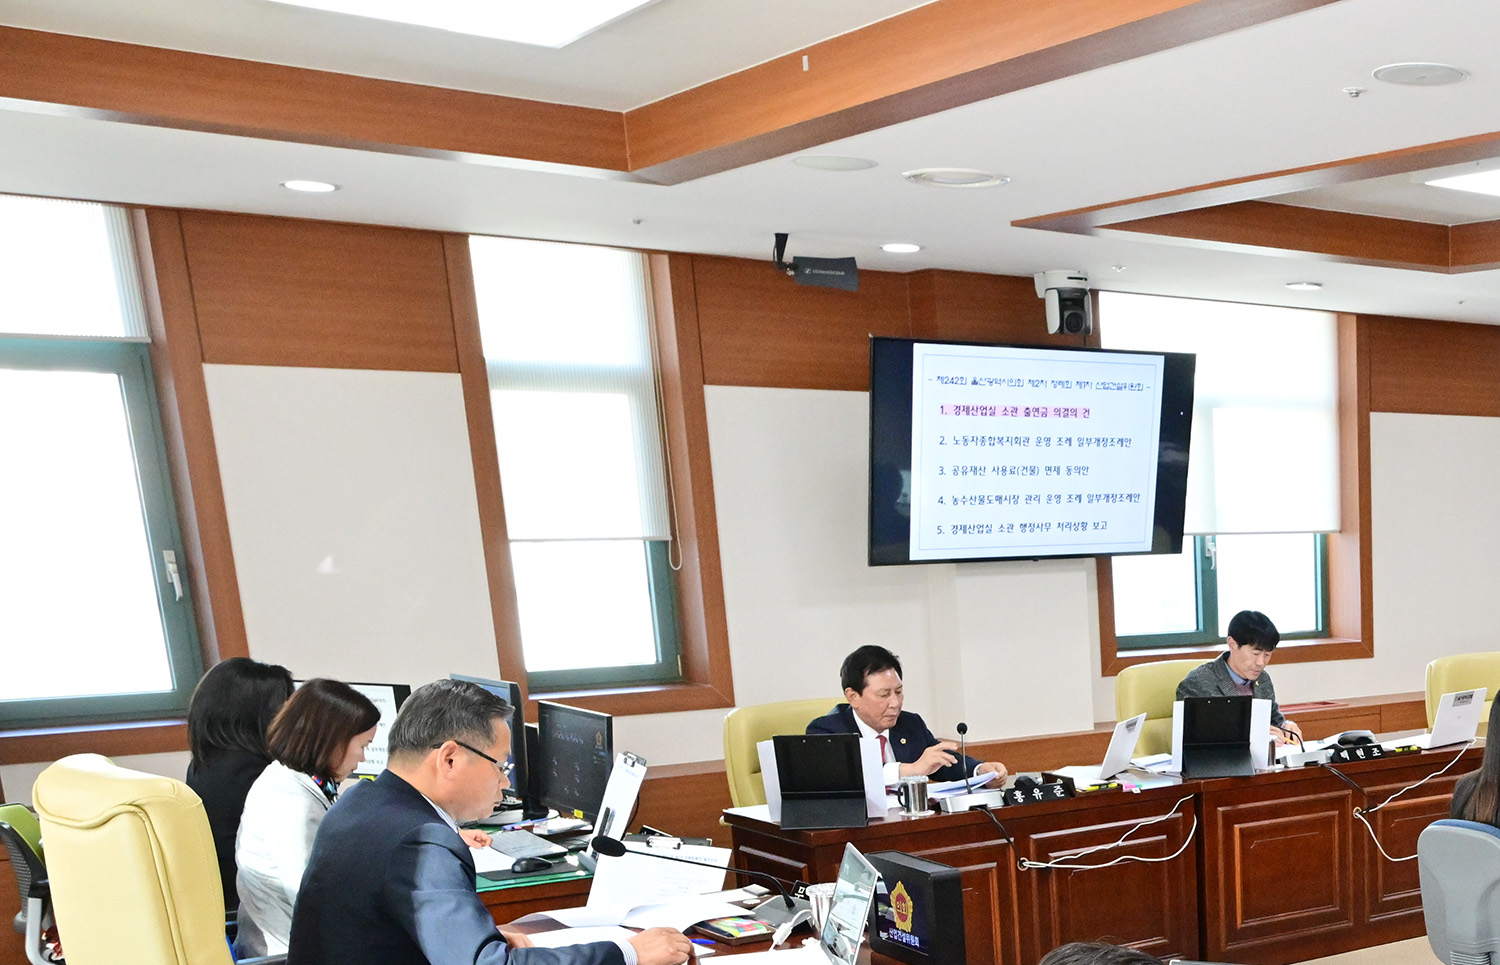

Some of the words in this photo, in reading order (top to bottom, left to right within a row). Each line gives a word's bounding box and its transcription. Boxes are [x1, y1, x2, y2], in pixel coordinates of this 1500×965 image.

[940, 406, 947, 415] 1.
[953, 405, 996, 416] 경제산업실
[1002, 406, 1018, 417] 소관
[1024, 406, 1048, 418] 출연금
[1054, 407, 1077, 418] 의결의
[1083, 408, 1090, 418] 건
[940, 437, 947, 445] 2.
[953, 436, 1030, 447] 노동자종합복지회관
[1035, 436, 1051, 447] 운영
[1056, 437, 1072, 447] 조례
[1077, 437, 1131, 448] 일부개정조례안
[939, 467, 946, 475] 3.
[952, 465, 986, 476] 공유재산
[991, 465, 1040, 477] 사용료(건물)
[1045, 465, 1062, 476] 면제
[1066, 465, 1088, 476] 동의안
[938, 497, 946, 505] 4.
[951, 494, 1019, 506] 농수산물도매시장
[1025, 494, 1040, 505] 관리
[1046, 494, 1061, 505] 운영
[1066, 493, 1082, 504] 조례
[1087, 493, 1140, 504] 일부개정조례안
[937, 526, 944, 534] 5.
[951, 524, 993, 535] 경제산업실
[998, 523, 1014, 534] 소관
[1019, 523, 1051, 533] 행정사무
[1057, 522, 1088, 532] 처리상황
[1093, 521, 1107, 531] 보고
